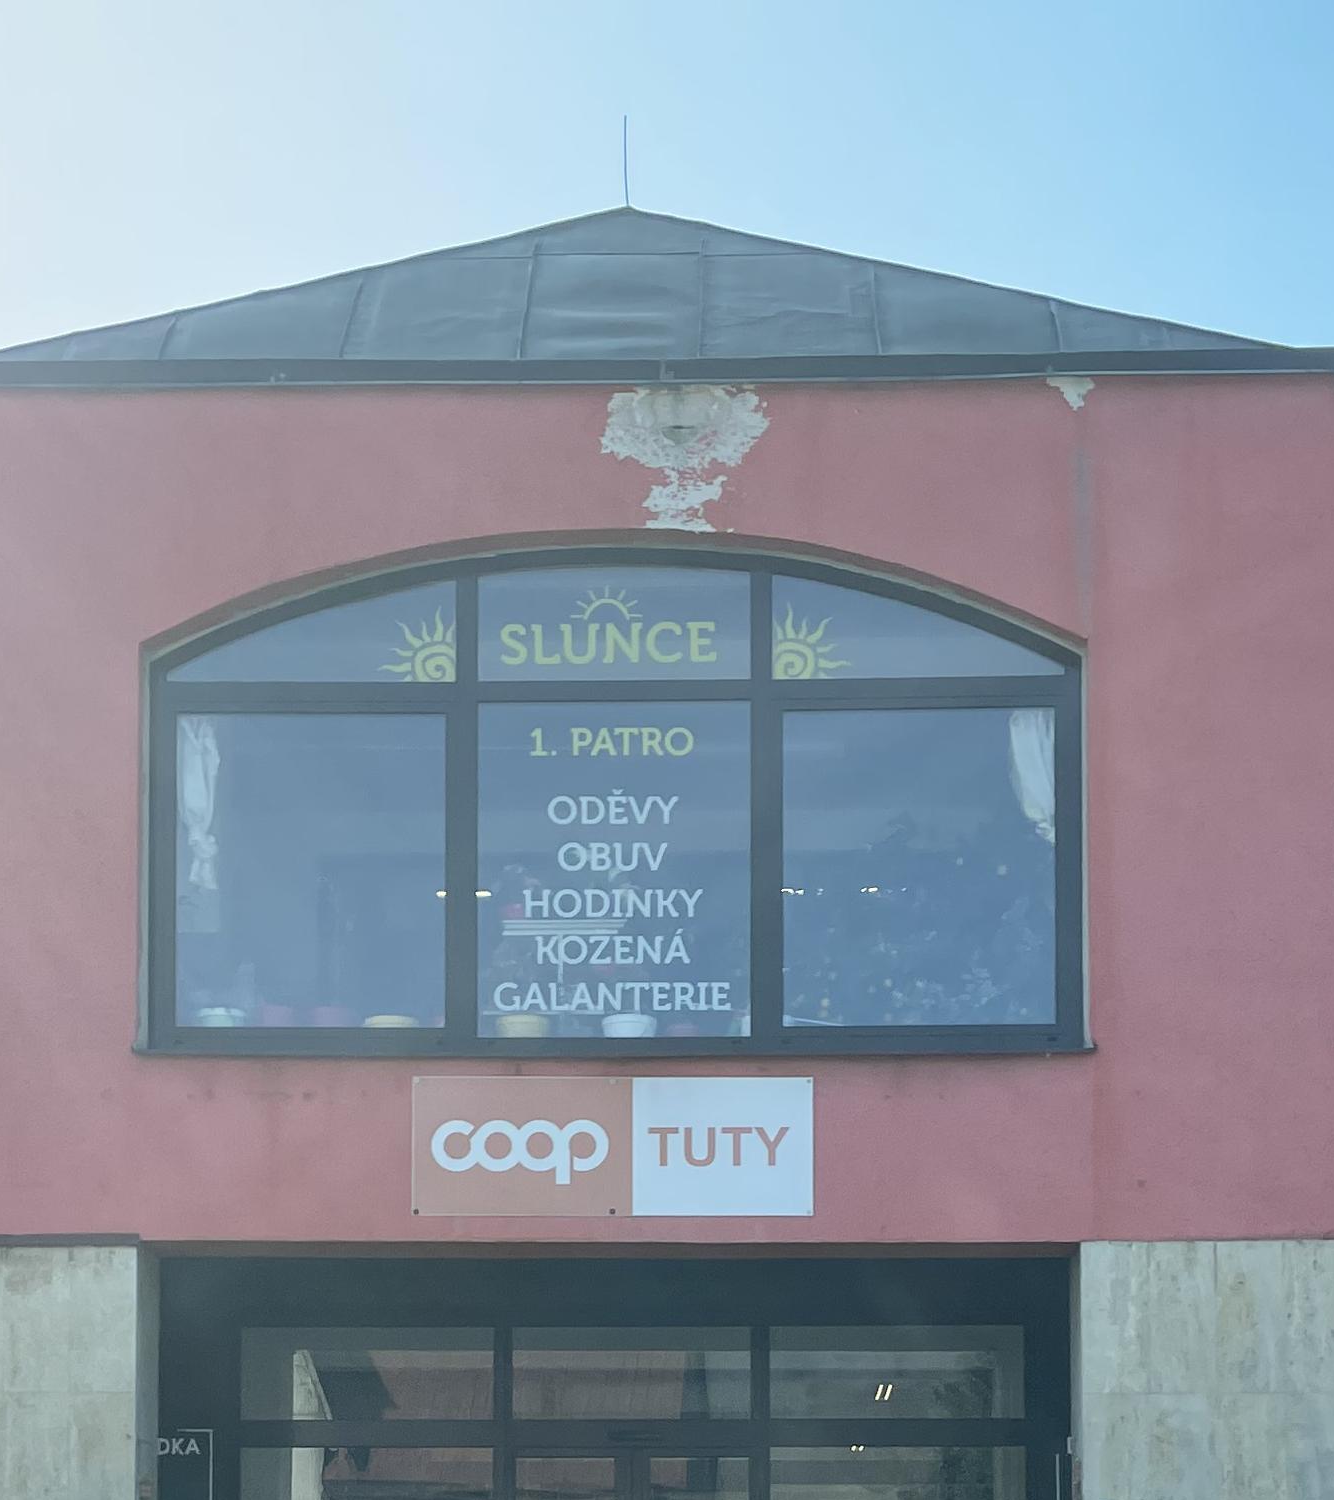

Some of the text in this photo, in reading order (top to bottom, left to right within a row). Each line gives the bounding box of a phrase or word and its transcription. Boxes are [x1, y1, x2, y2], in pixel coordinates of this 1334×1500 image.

[499, 620, 717, 665] SLUNCE
[529, 727, 694, 756] 1. PATRO
[547, 789, 679, 825] ODĚVY
[557, 842, 667, 872] OBUV
[523, 888, 703, 918] HODINKY
[493, 982, 732, 1012] GALANTERIE
[431, 1119, 790, 1185] coop TUTY
